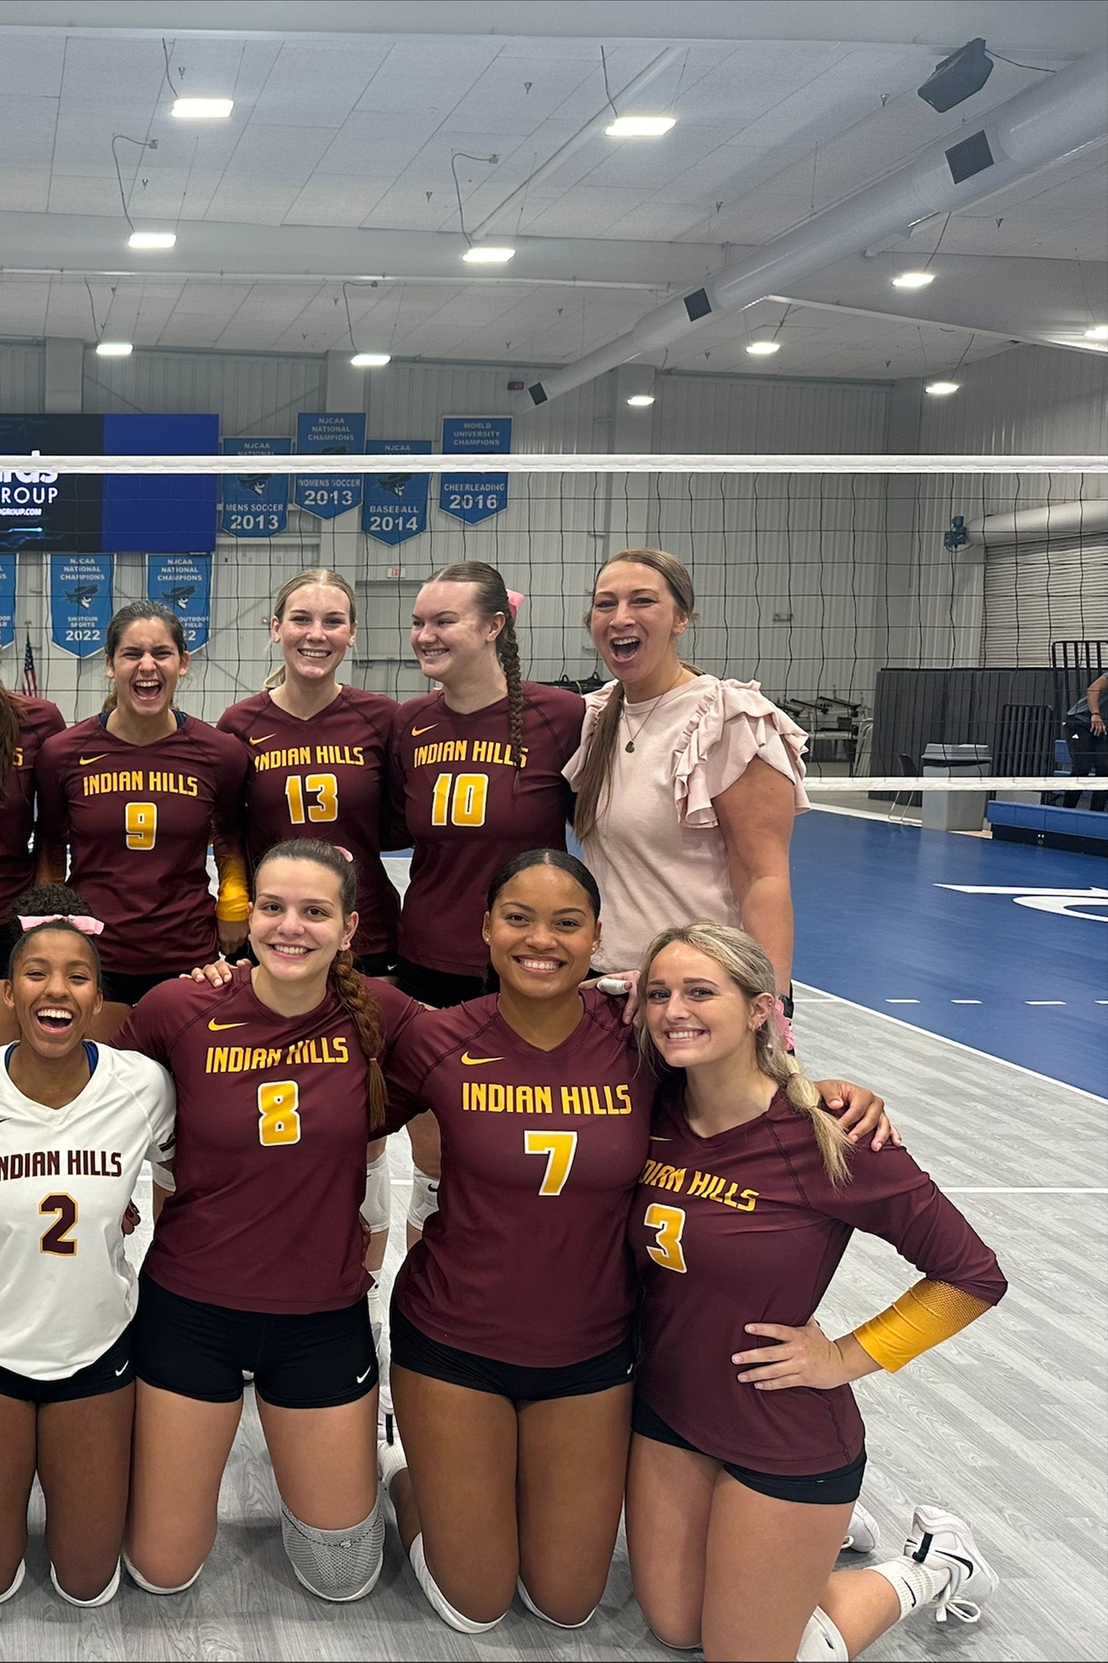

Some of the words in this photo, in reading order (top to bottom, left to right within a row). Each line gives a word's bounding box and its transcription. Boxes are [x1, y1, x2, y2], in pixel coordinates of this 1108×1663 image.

[311, 425, 351, 433] NATIONAL
[318, 416, 345, 424] NJCAA
[307, 433, 354, 441] CHAMPIONS
[453, 430, 501, 438] UNIVERSITY
[453, 438, 500, 446] CHAMPIONS
[303, 490, 353, 505] 2013
[443, 483, 506, 492] CHEERLEADING
[251, 503, 284, 511] SOCCER
[369, 505, 419, 514] BASEBALL
[449, 494, 499, 510] 2016
[230, 514, 279, 530] 2013
[370, 516, 418, 532] 2014
[65, 630, 101, 641] 2022
[253, 746, 312, 773] INDIAN
[316, 746, 365, 767] HILLS
[414, 740, 469, 768] INDIAN
[83, 771, 144, 797] INDIAN
[149, 771, 199, 797] HILLS
[284, 773, 339, 825] 13
[431, 772, 490, 828] 10
[124, 801, 158, 851] 9
[205, 1046, 283, 1074] INDIAN
[286, 1036, 350, 1067] HILLS
[462, 1082, 553, 1114] INDIAN
[560, 1084, 632, 1116] HILLS
[257, 1079, 302, 1147] 8
[67, 1150, 123, 1178] HILLS
[524, 1129, 579, 1197] 7
[639, 1158, 688, 1193] DIAN
[687, 1170, 760, 1212] HILLS
[38, 1191, 79, 1257] 2
[644, 1202, 688, 1274] 3
